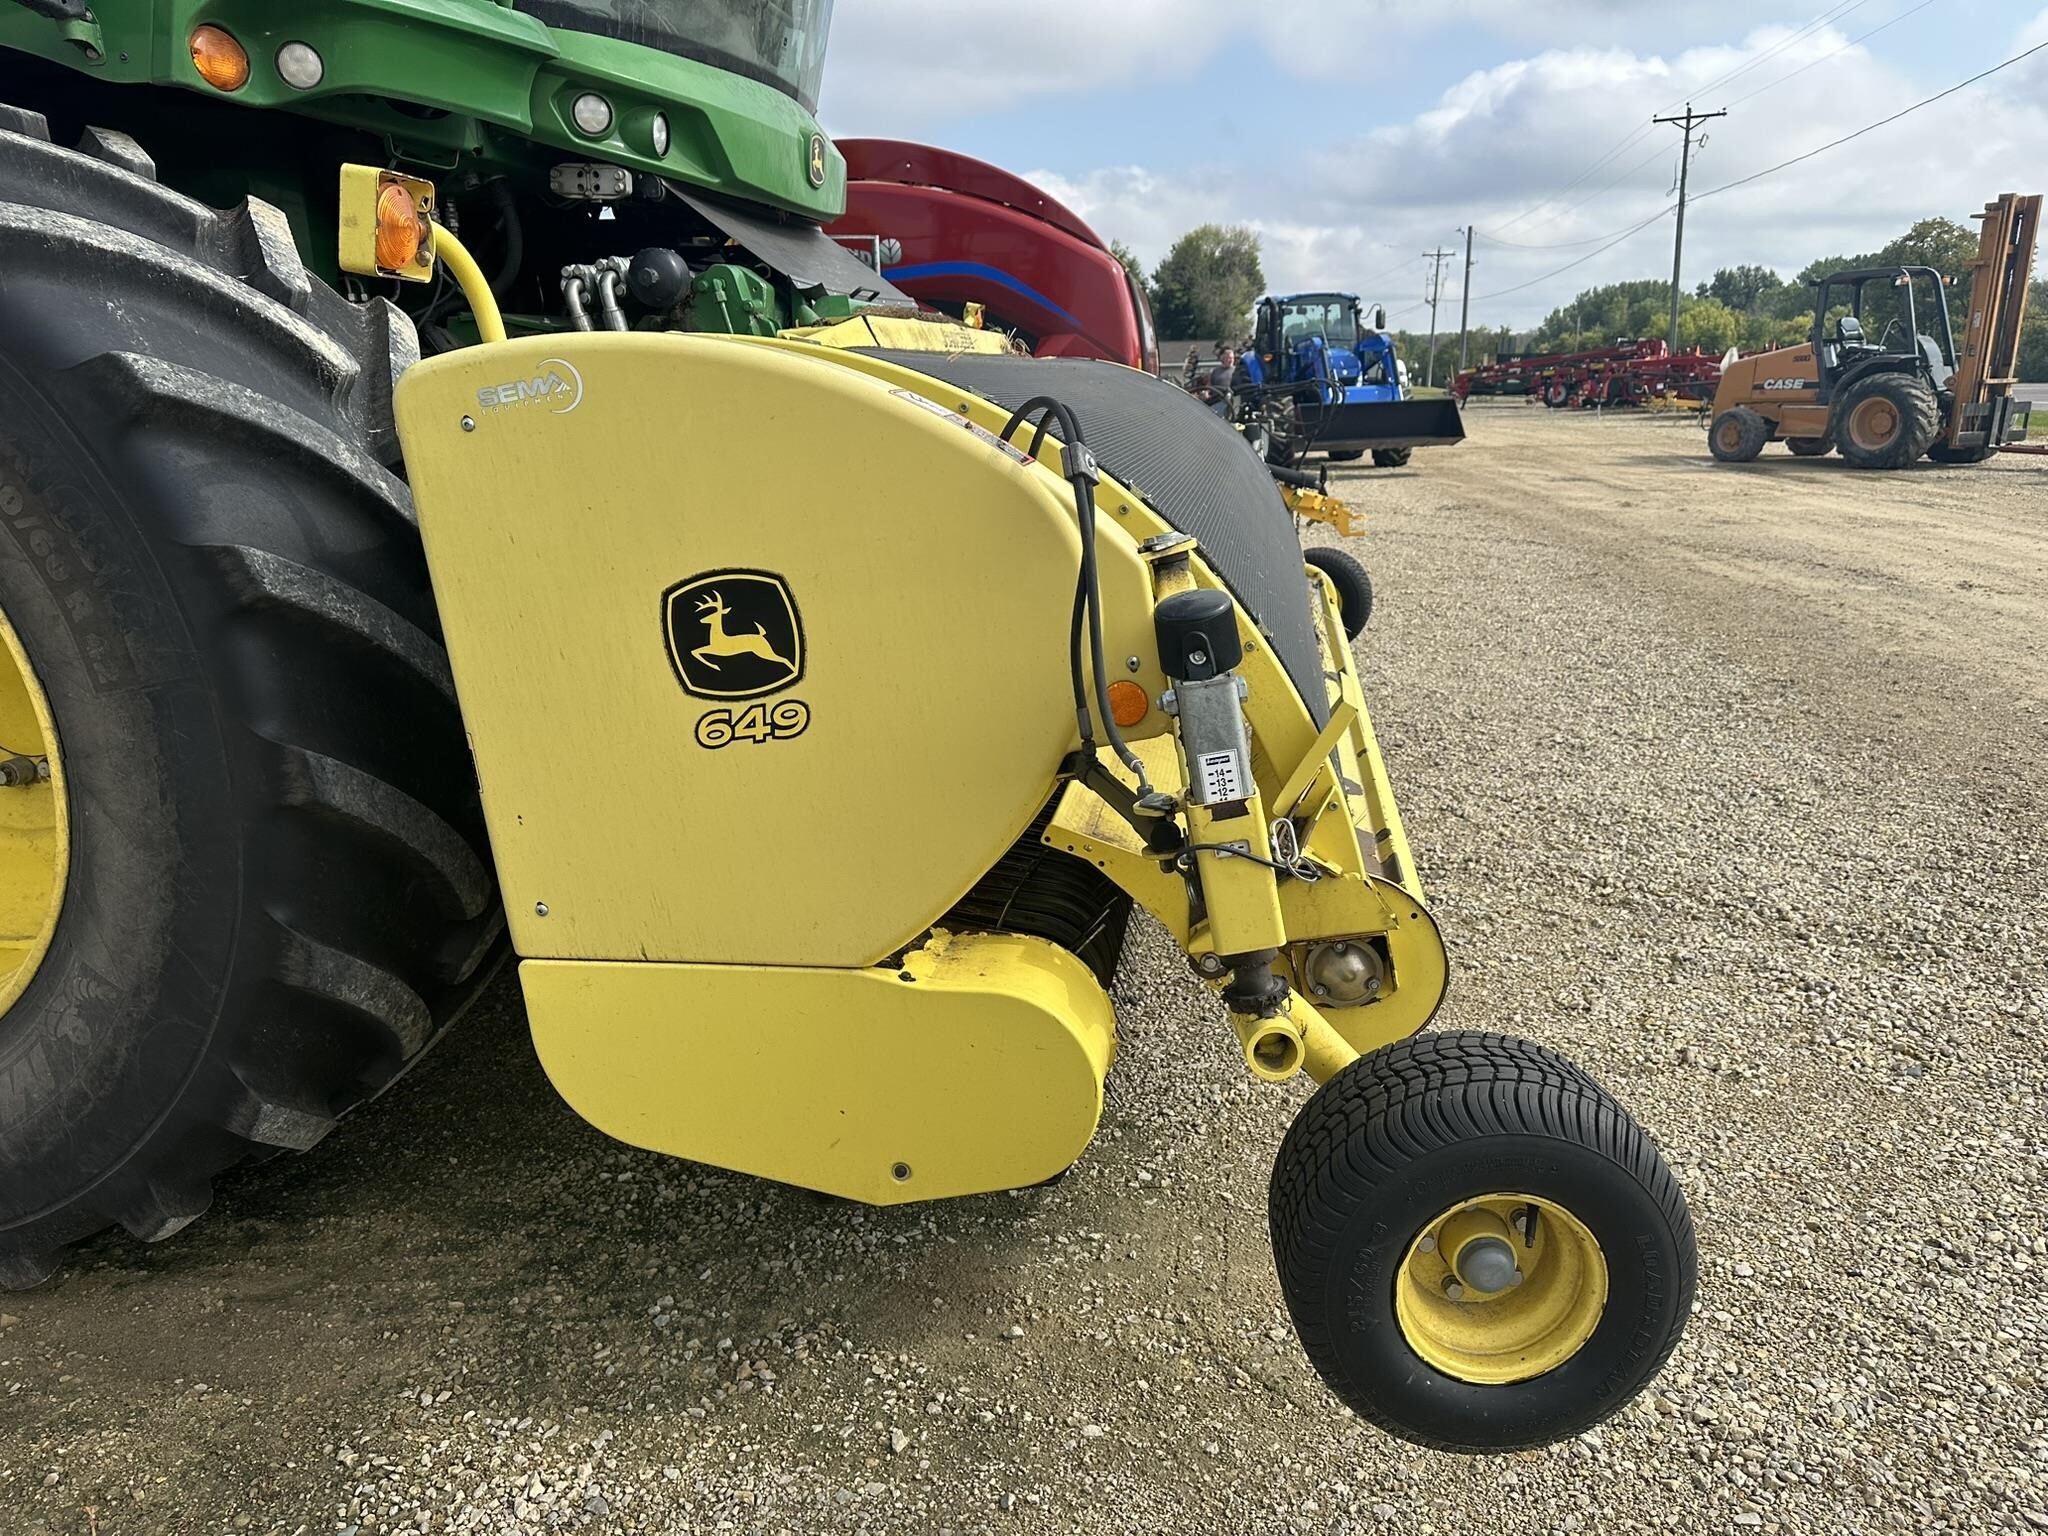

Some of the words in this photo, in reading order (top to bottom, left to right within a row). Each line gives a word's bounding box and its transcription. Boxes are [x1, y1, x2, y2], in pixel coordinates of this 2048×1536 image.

[477, 371, 571, 408] SEMA
[1763, 378, 1805, 390] CASE
[694, 699, 811, 750] 649
[1214, 768, 1226, 778] 14
[1216, 777, 1227, 787] 13
[1217, 787, 1228, 797] 12
